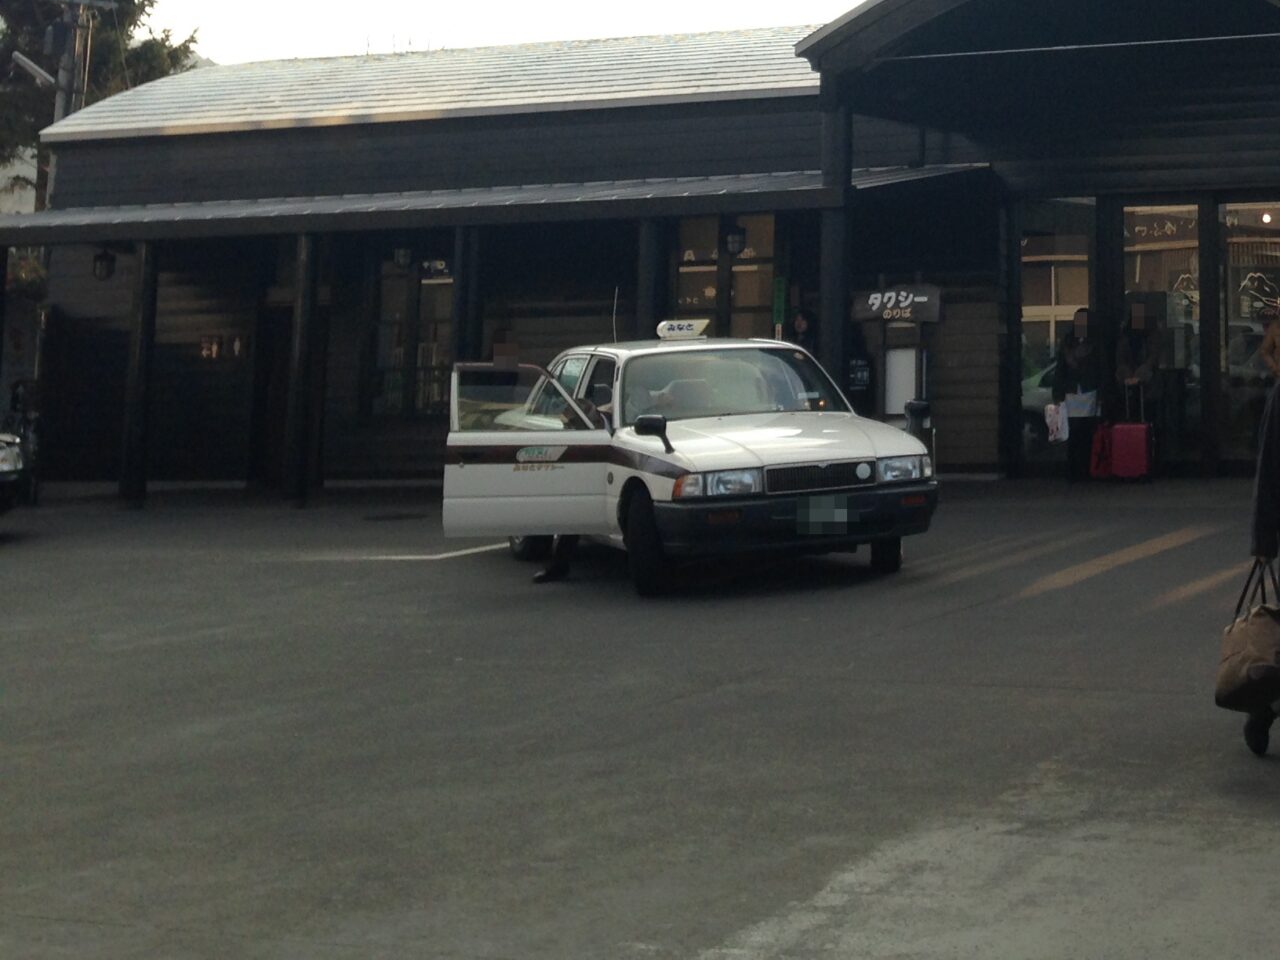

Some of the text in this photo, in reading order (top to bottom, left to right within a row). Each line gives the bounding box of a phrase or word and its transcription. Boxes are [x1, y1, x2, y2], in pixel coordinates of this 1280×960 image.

[868, 291, 928, 311] タクシー
[883, 308, 912, 319] のりば
